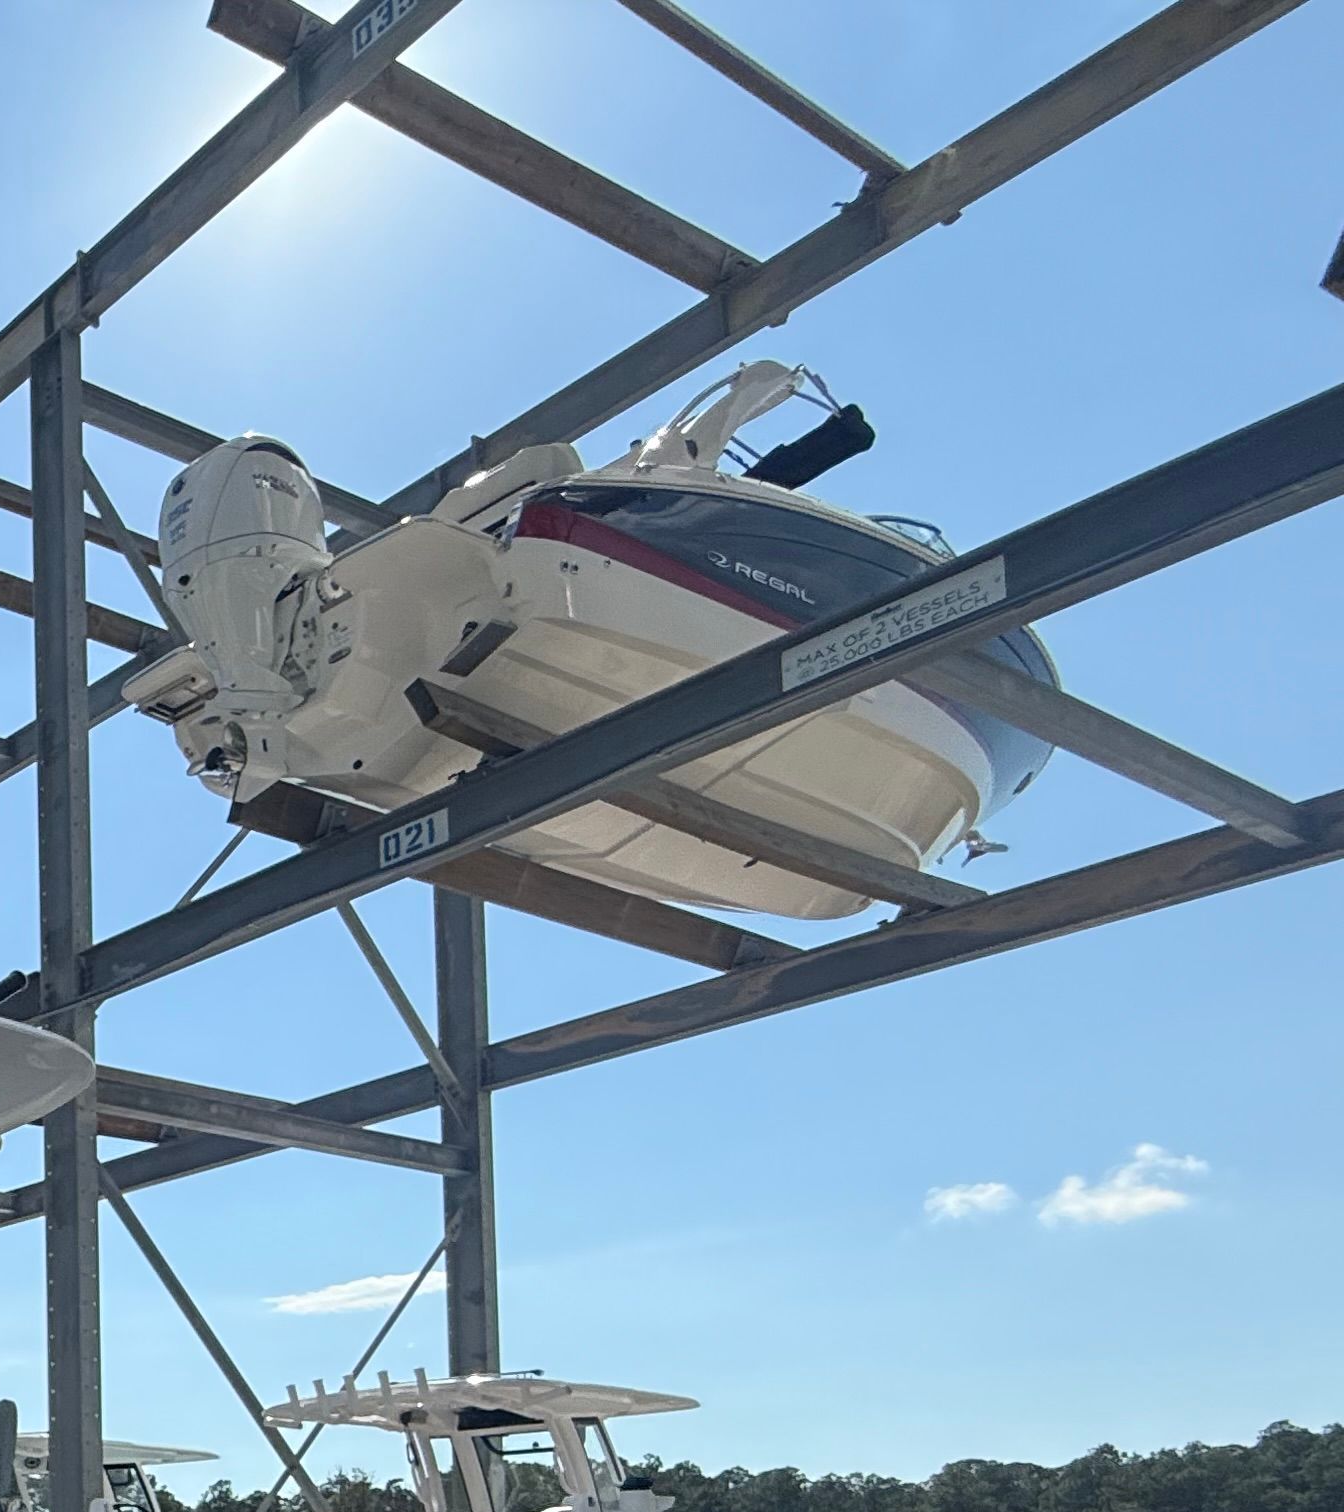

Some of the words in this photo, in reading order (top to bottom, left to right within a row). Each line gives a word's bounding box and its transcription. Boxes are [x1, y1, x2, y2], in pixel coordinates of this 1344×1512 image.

[734, 562, 816, 605] REGAL
[797, 642, 837, 667] MAX
[843, 627, 870, 648] OF
[875, 620, 887, 635] 2
[893, 581, 981, 626] VESSELS
[887, 618, 926, 643] LBS
[931, 591, 990, 625] EACH
[383, 817, 435, 863] 021
